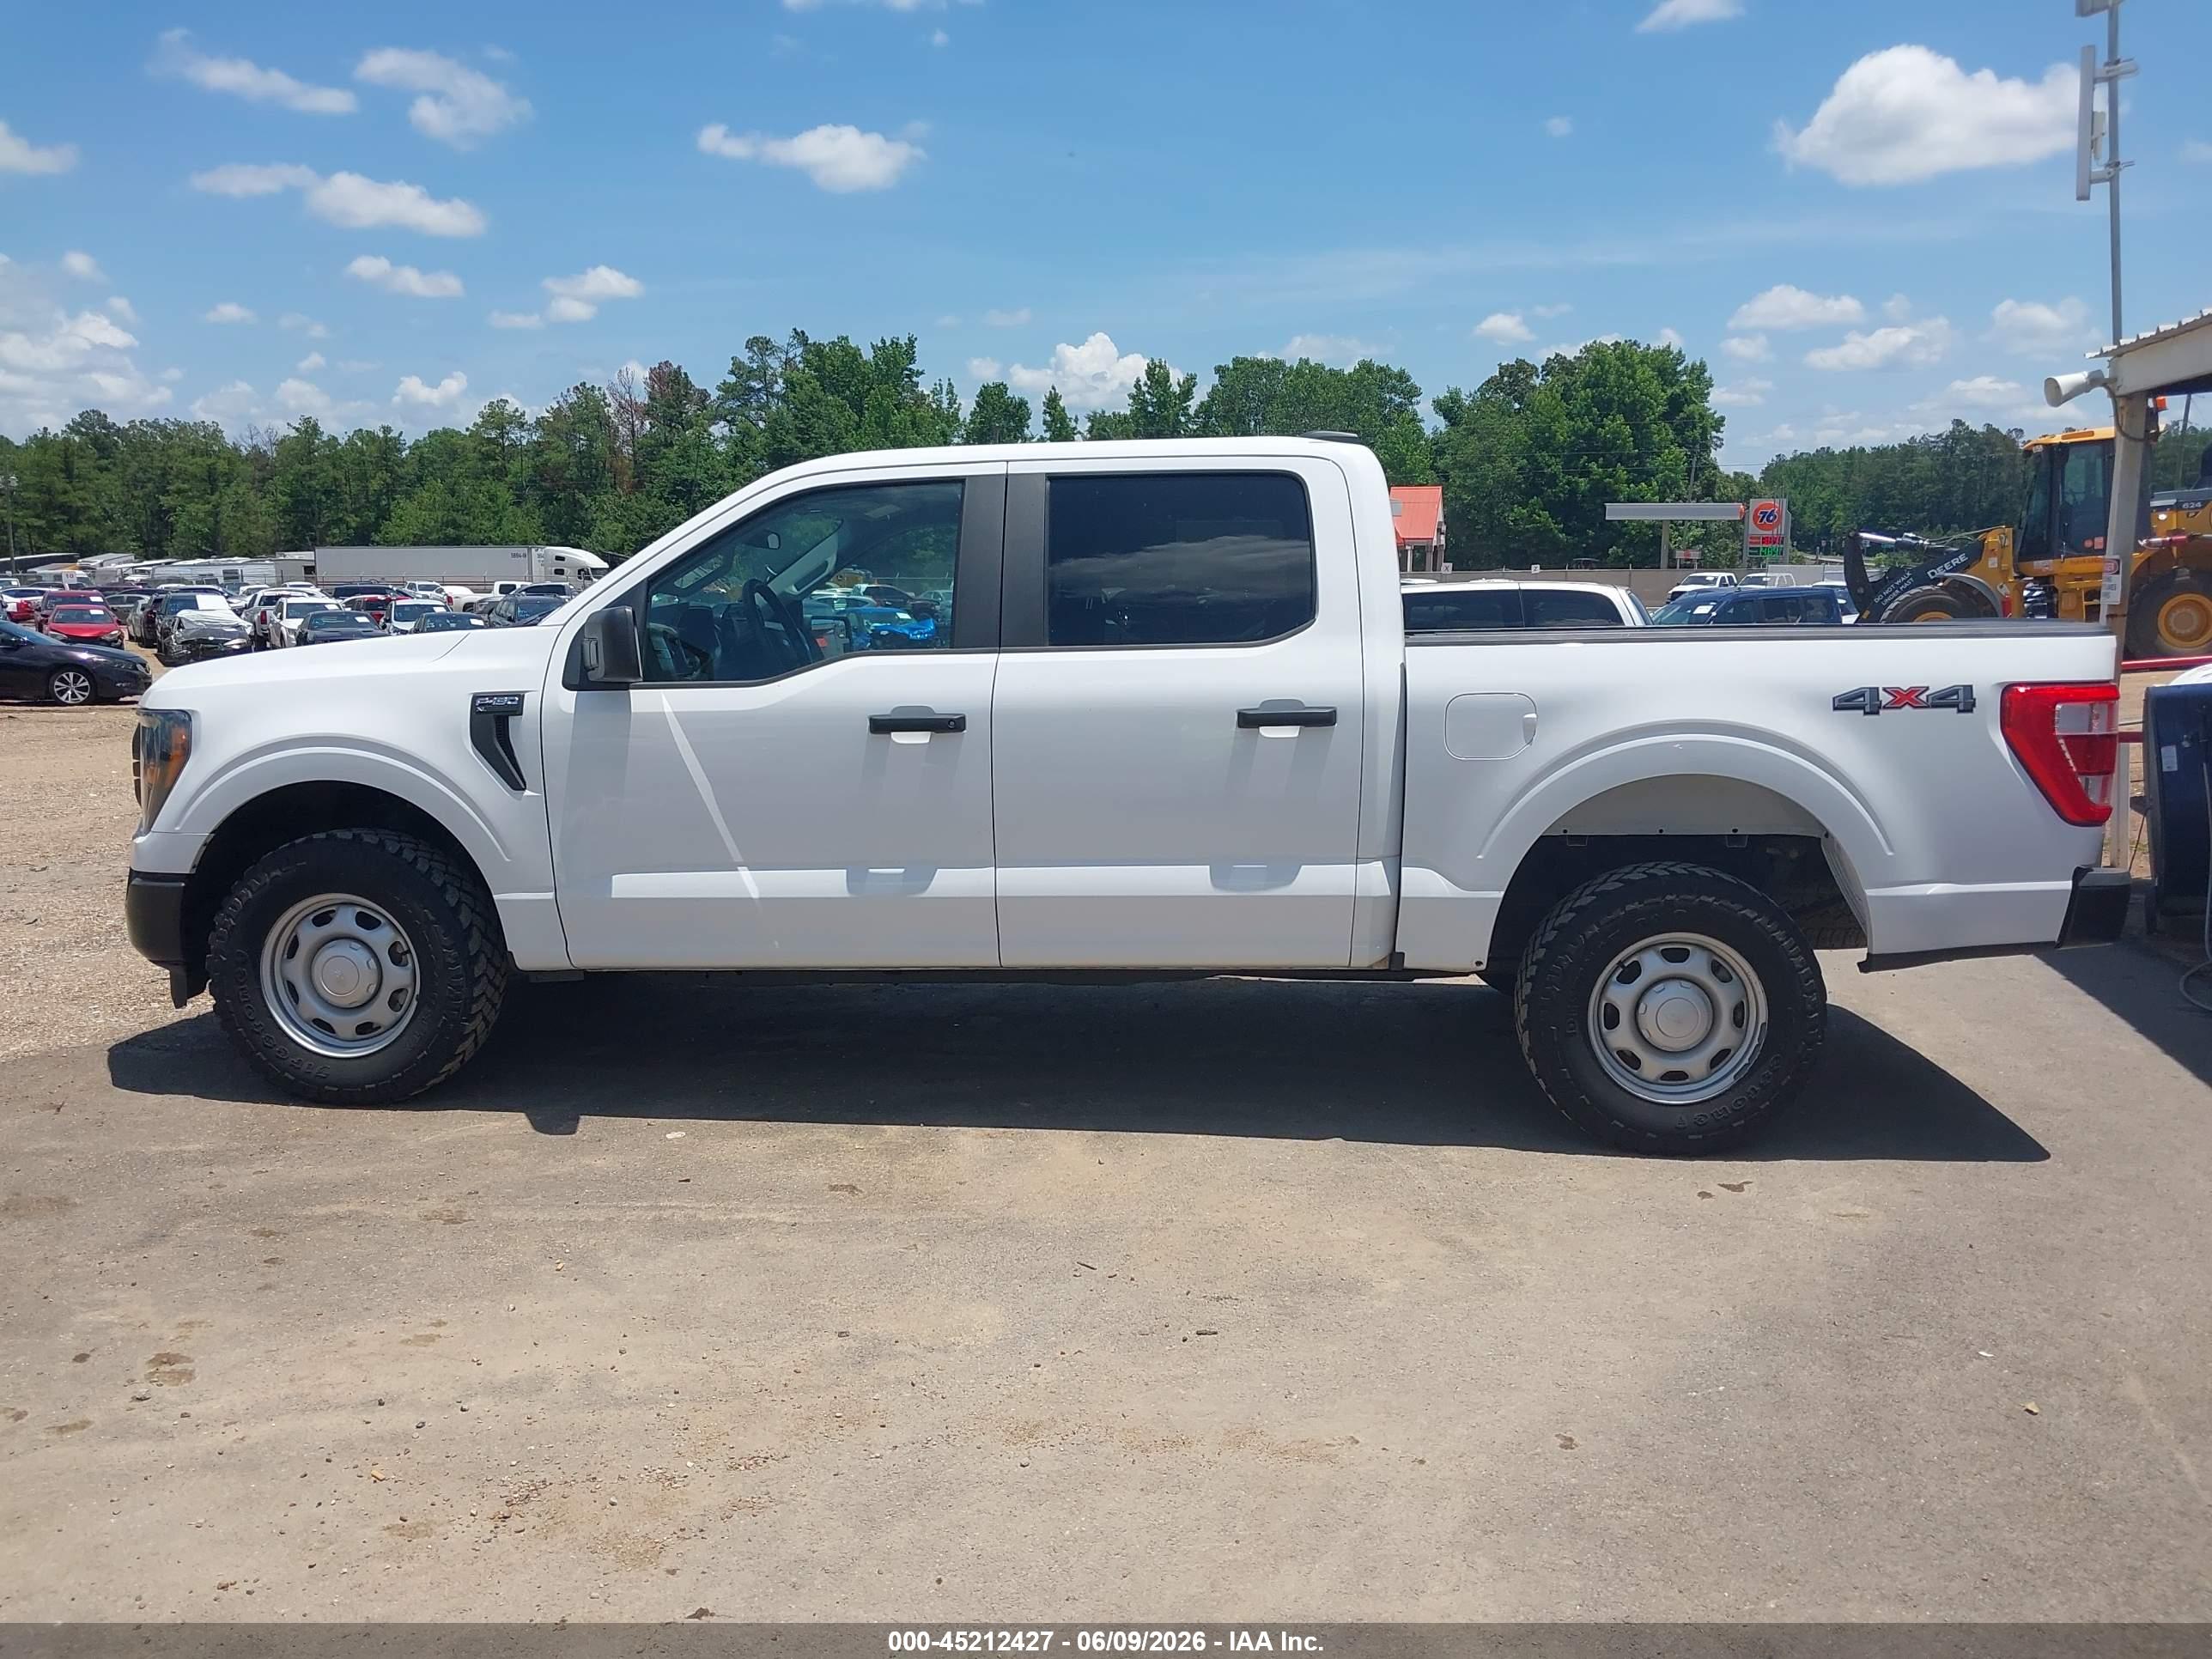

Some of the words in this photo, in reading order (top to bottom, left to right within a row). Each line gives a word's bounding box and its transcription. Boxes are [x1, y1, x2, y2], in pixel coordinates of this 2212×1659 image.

[1758, 508, 1778, 525] 76
[1927, 553, 1968, 580] DEERE
[1874, 594, 1884, 604] DO
[1883, 585, 1897, 594] NOT
[1895, 571, 1911, 586] WALK
[1881, 589, 1901, 605] UNDER
[1899, 577, 1915, 591] MAST
